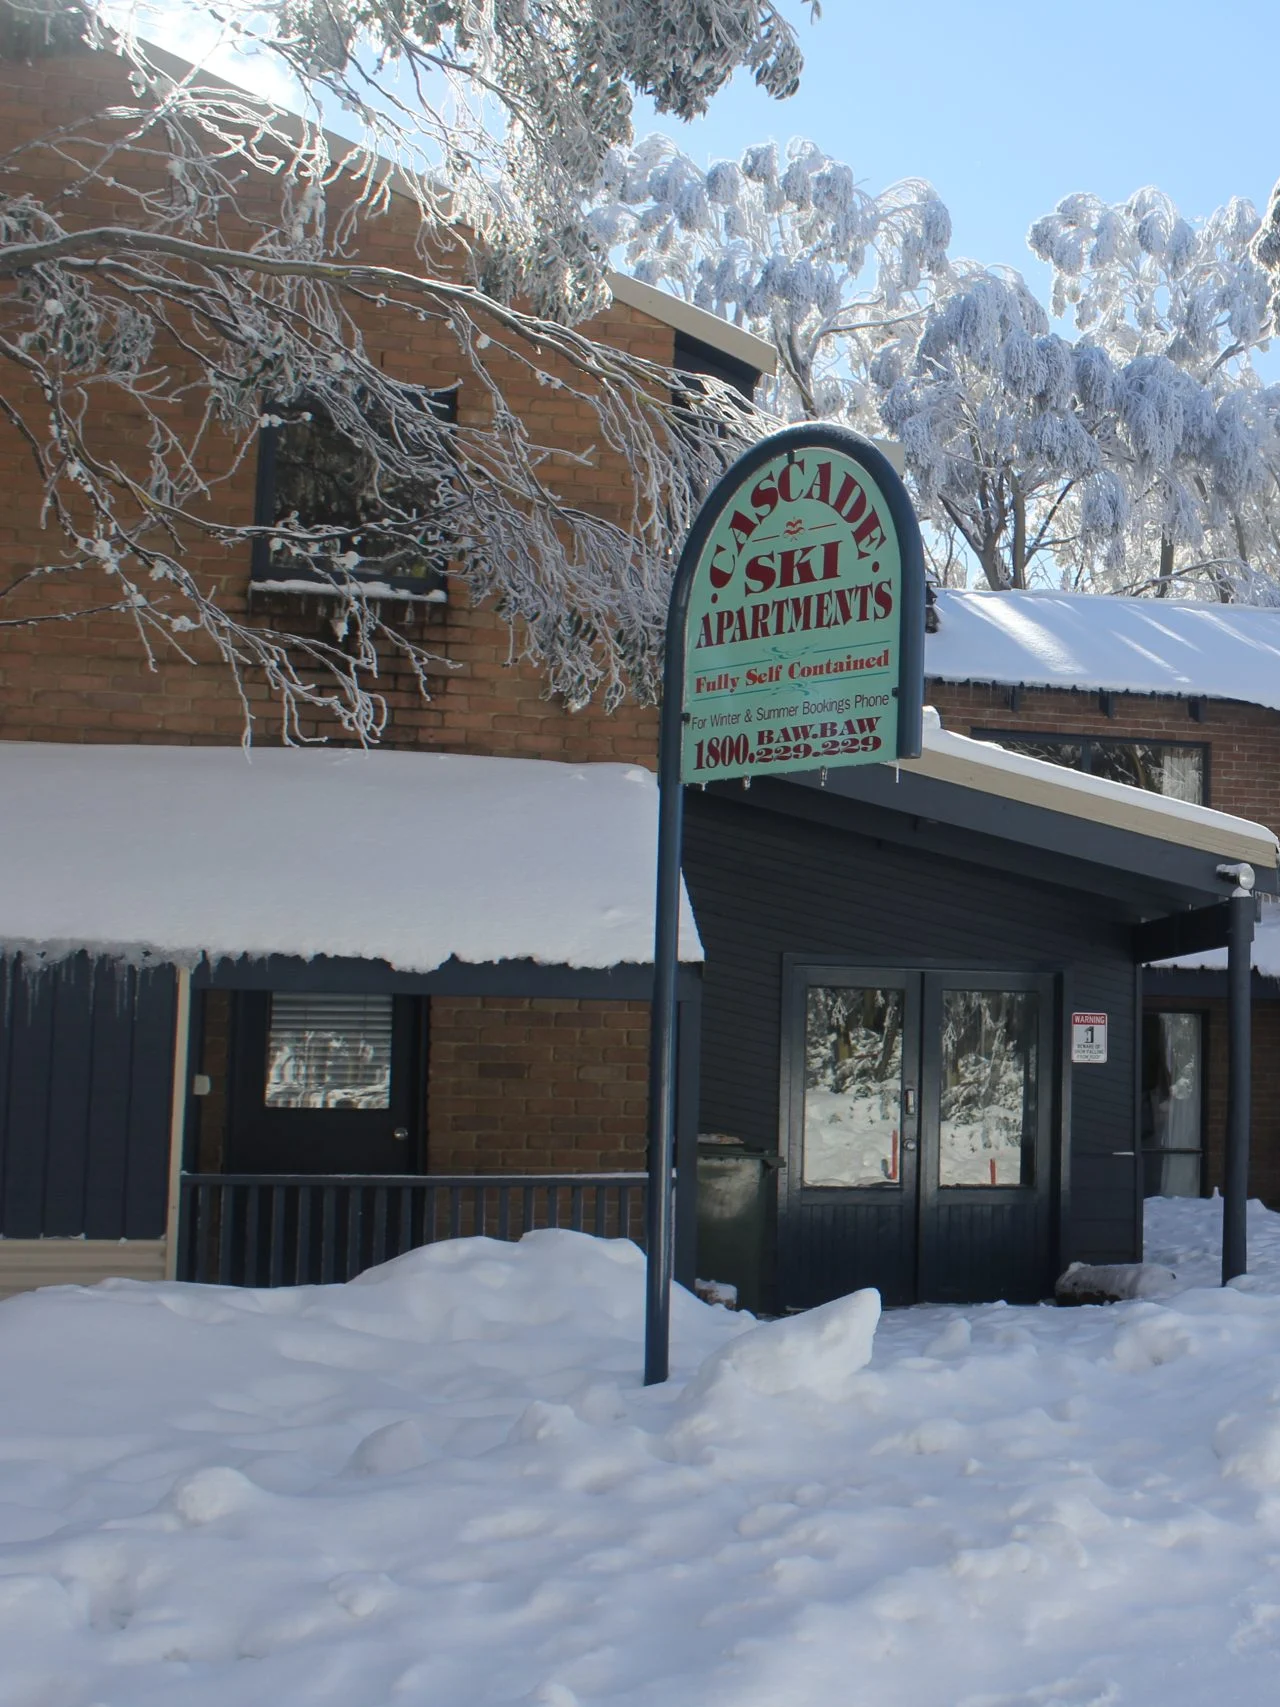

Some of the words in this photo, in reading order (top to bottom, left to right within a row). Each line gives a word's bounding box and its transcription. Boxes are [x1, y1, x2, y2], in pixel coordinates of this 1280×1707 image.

[709, 459, 887, 589] CASCADE
[744, 540, 843, 597] SKI
[695, 578, 893, 649] APARTMENTS
[695, 674, 740, 693] Fully
[745, 664, 783, 687] Self
[787, 649, 890, 680] Contained
[691, 716, 708, 730] For
[710, 709, 741, 728] Winter
[744, 708, 753, 723] &
[756, 704, 799, 721] Summer
[802, 692, 851, 715] Bookings
[854, 693, 890, 709] Phone
[1074, 1016, 1104, 1024] WARNING
